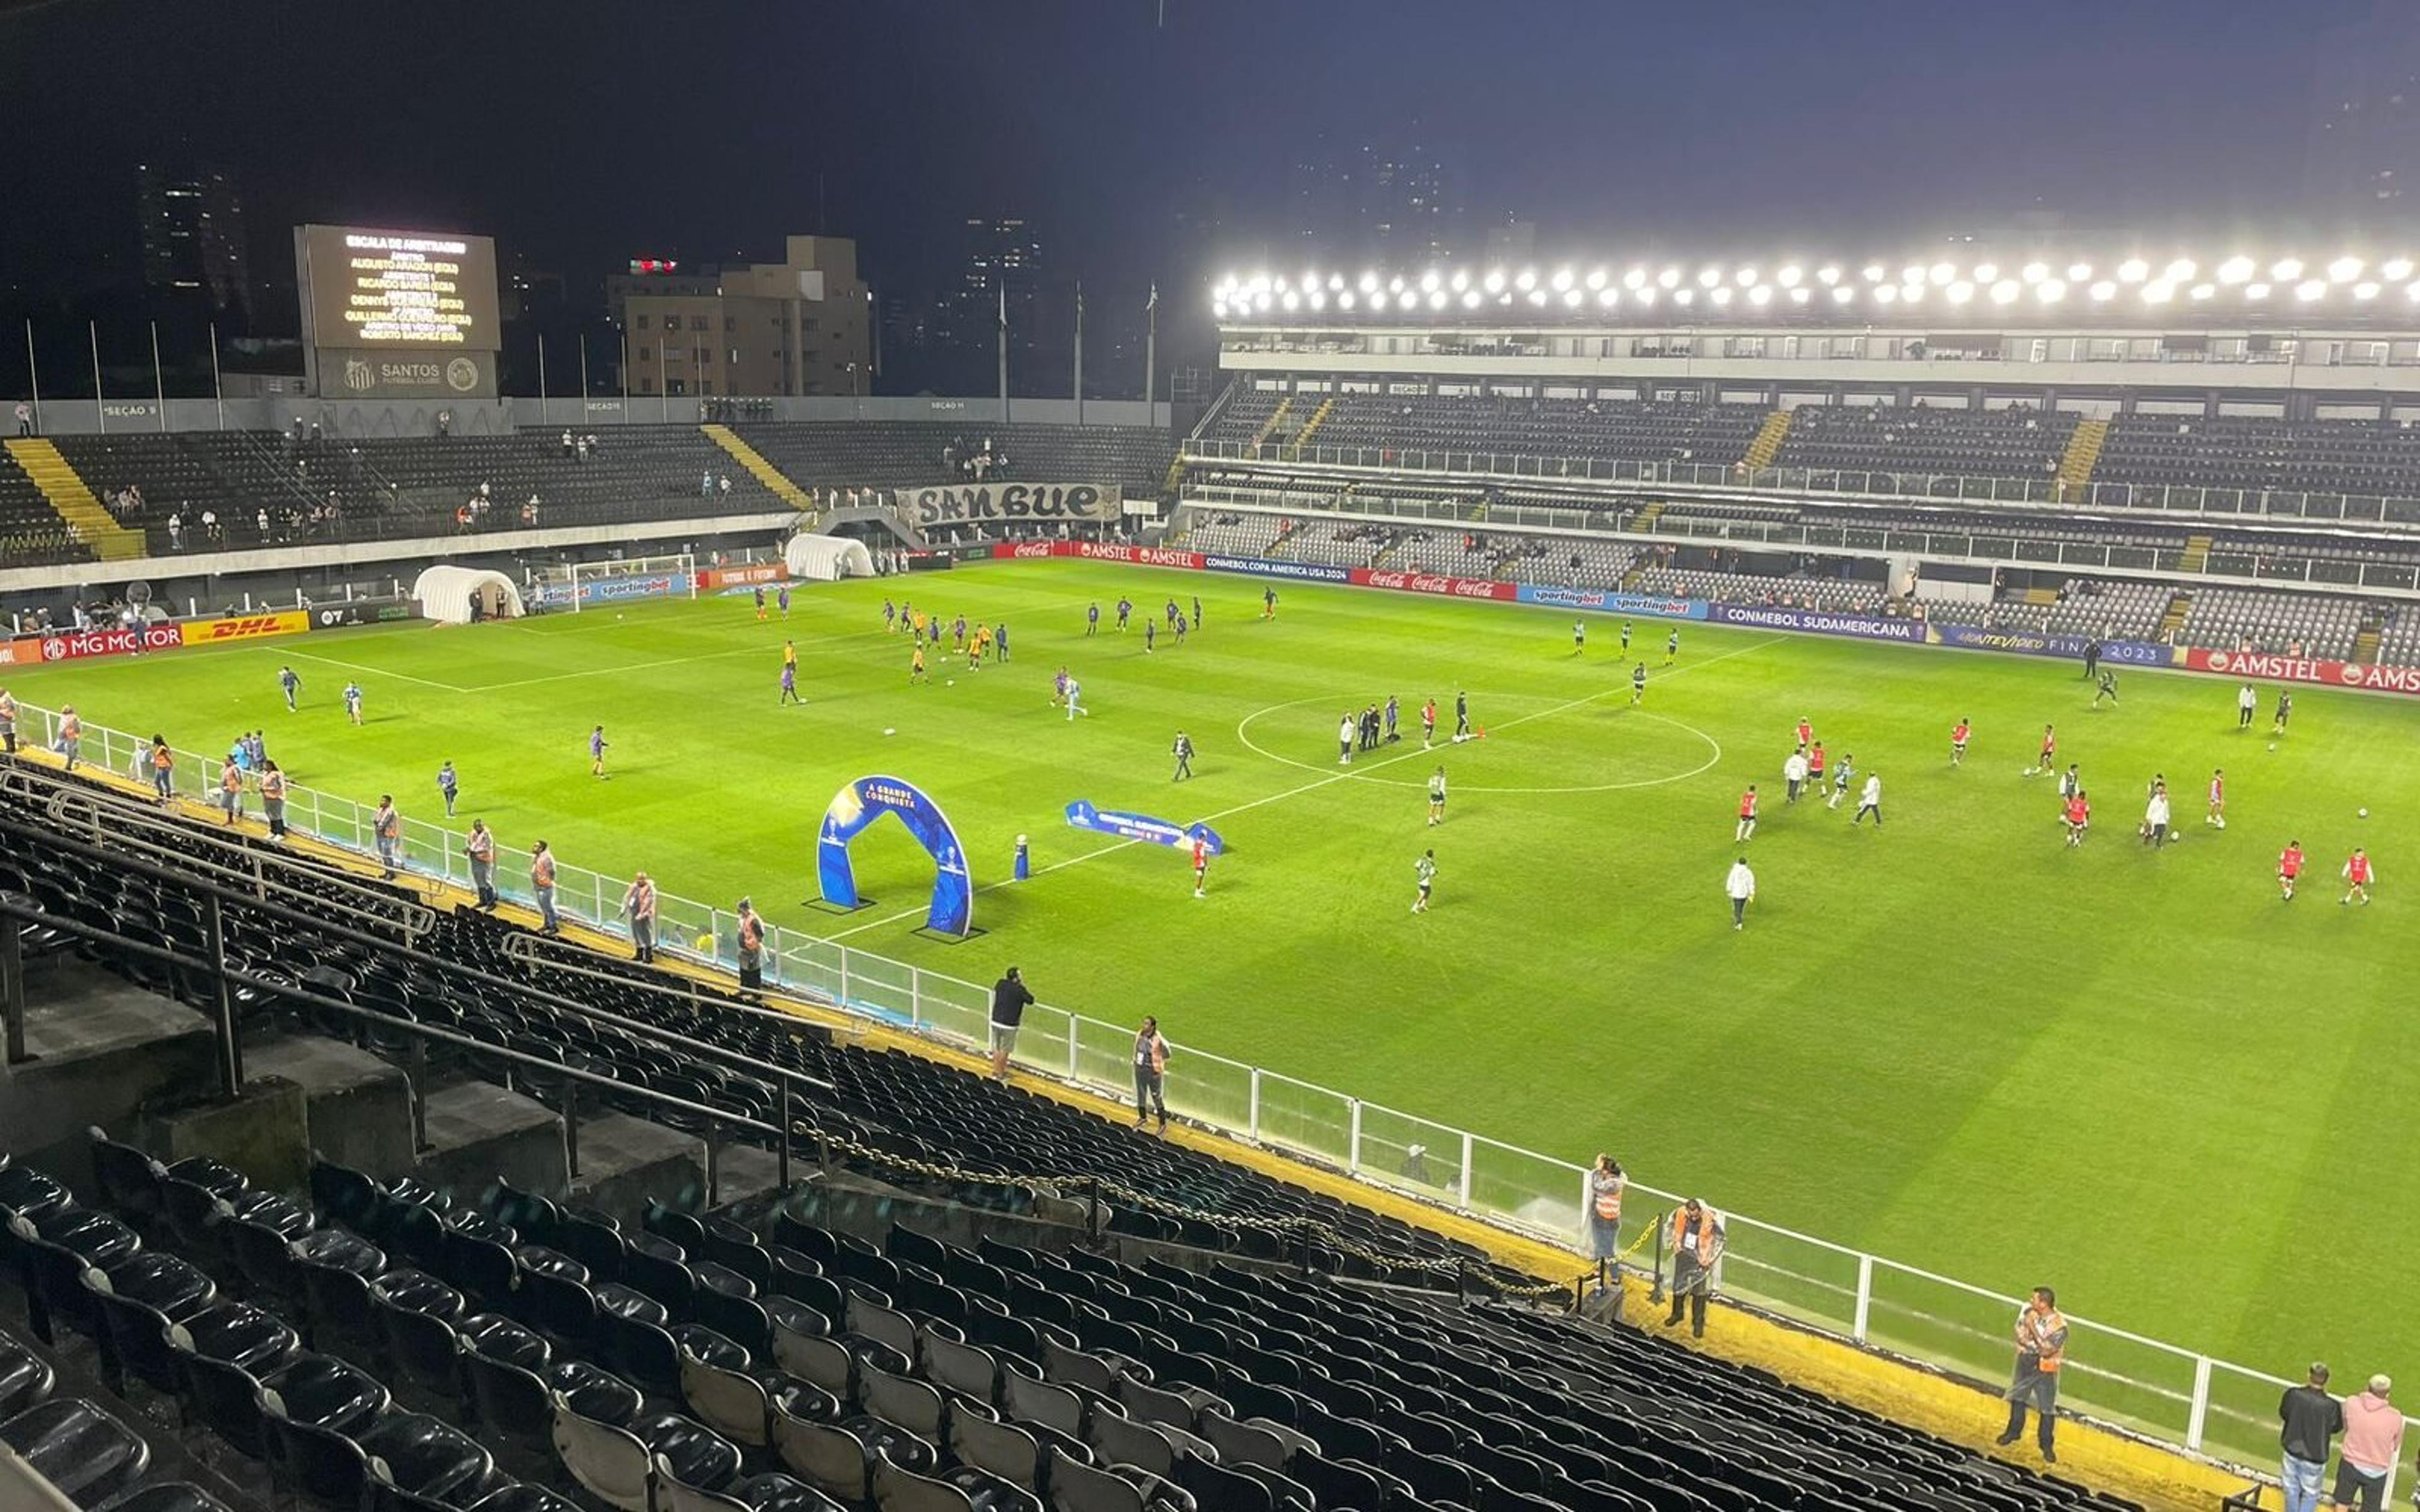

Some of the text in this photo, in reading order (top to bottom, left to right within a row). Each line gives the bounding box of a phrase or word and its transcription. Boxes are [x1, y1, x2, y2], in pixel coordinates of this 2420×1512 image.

[346, 235, 387, 249] ESCALA
[382, 364, 440, 377] SANTOS
[1091, 543, 1132, 560] AMSTEL
[1150, 551, 1194, 567] AMSTEL
[1206, 558, 1347, 580] CONMEBOL COPA AMERICA USA 2024
[602, 578, 670, 595] sportingbet
[1535, 590, 1603, 605] sportingbet
[1616, 598, 1688, 613] sportingbet
[213, 617, 280, 638] DHL
[1728, 608, 1910, 638] CONMEBOL SUDAMERICANA
[72, 636, 103, 655] MG
[2111, 646, 2157, 660] 2023
[2230, 654, 2321, 681] AMSTEL
[877, 785, 912, 799] GRANDE
